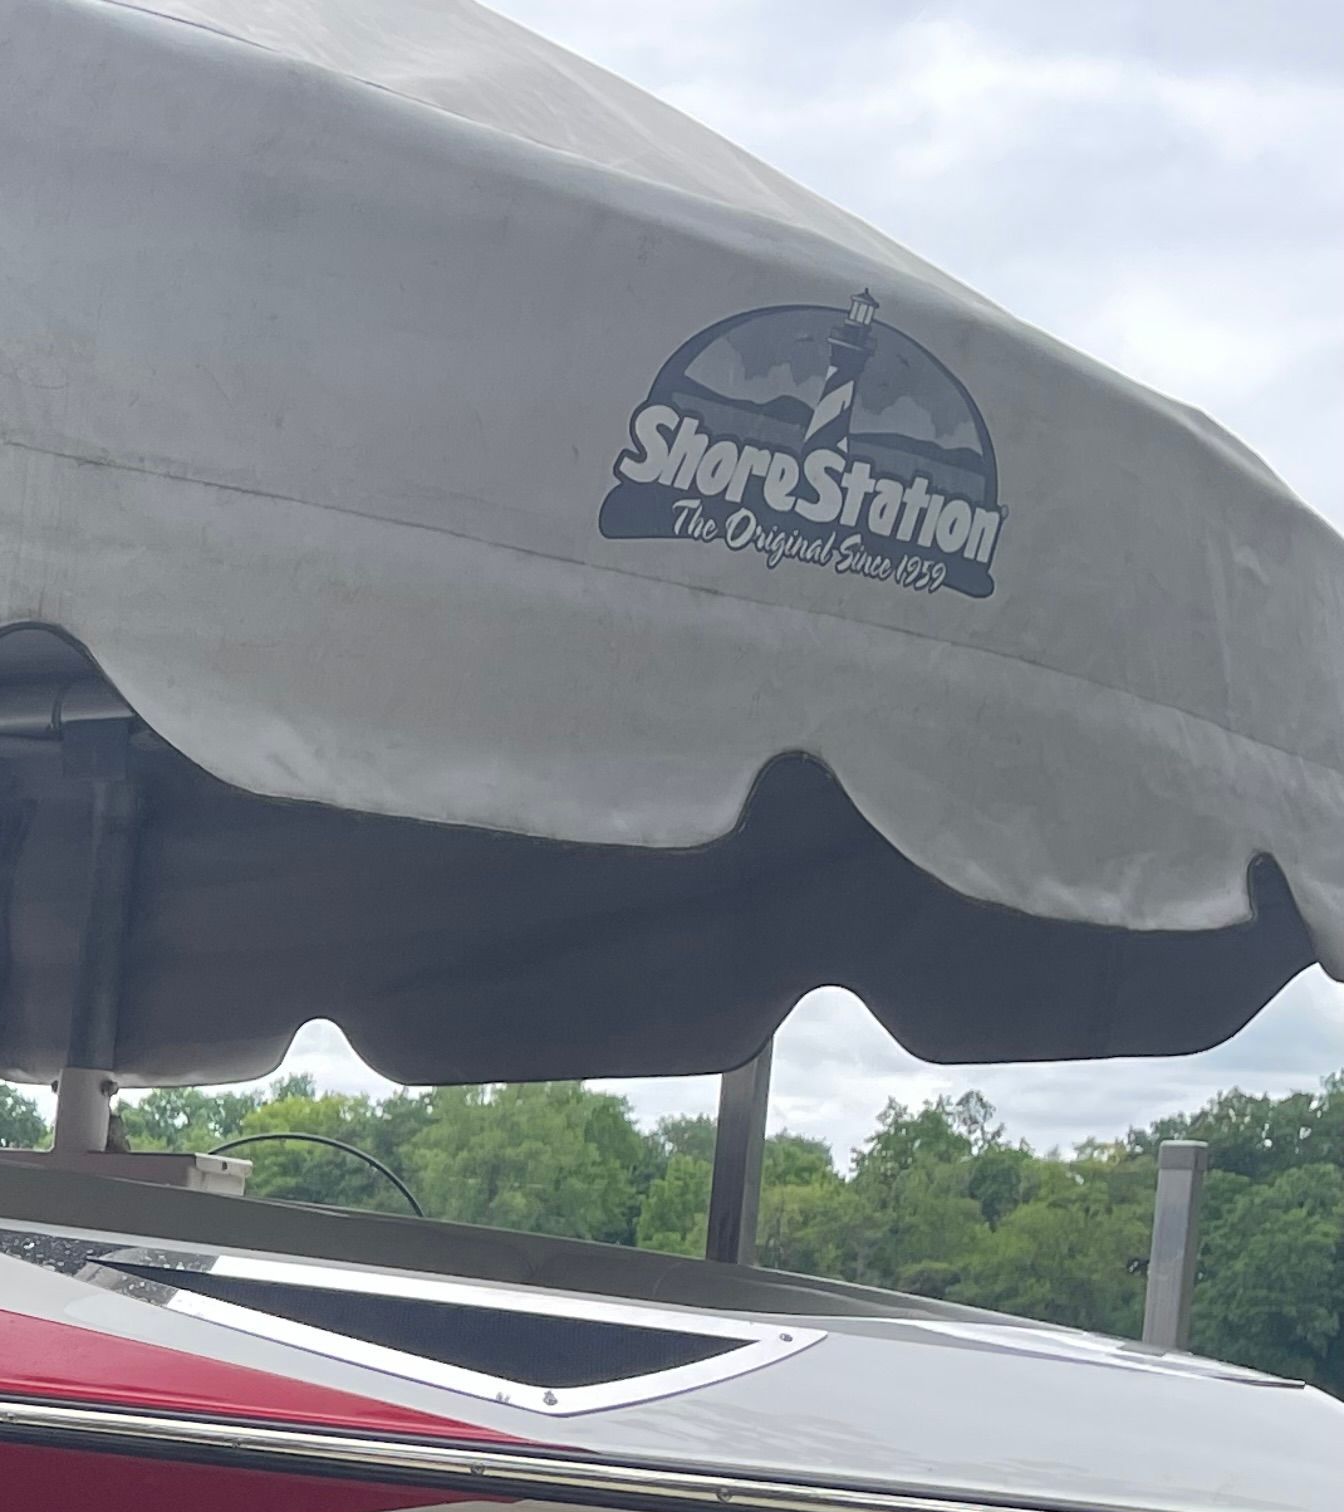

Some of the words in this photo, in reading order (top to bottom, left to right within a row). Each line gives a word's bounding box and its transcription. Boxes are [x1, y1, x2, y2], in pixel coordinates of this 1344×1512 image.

[619, 404, 1002, 563] ShoreStation
[672, 499, 719, 539] The
[725, 507, 838, 570] Original
[836, 534, 894, 580] Since
[894, 554, 948, 592] 1959
